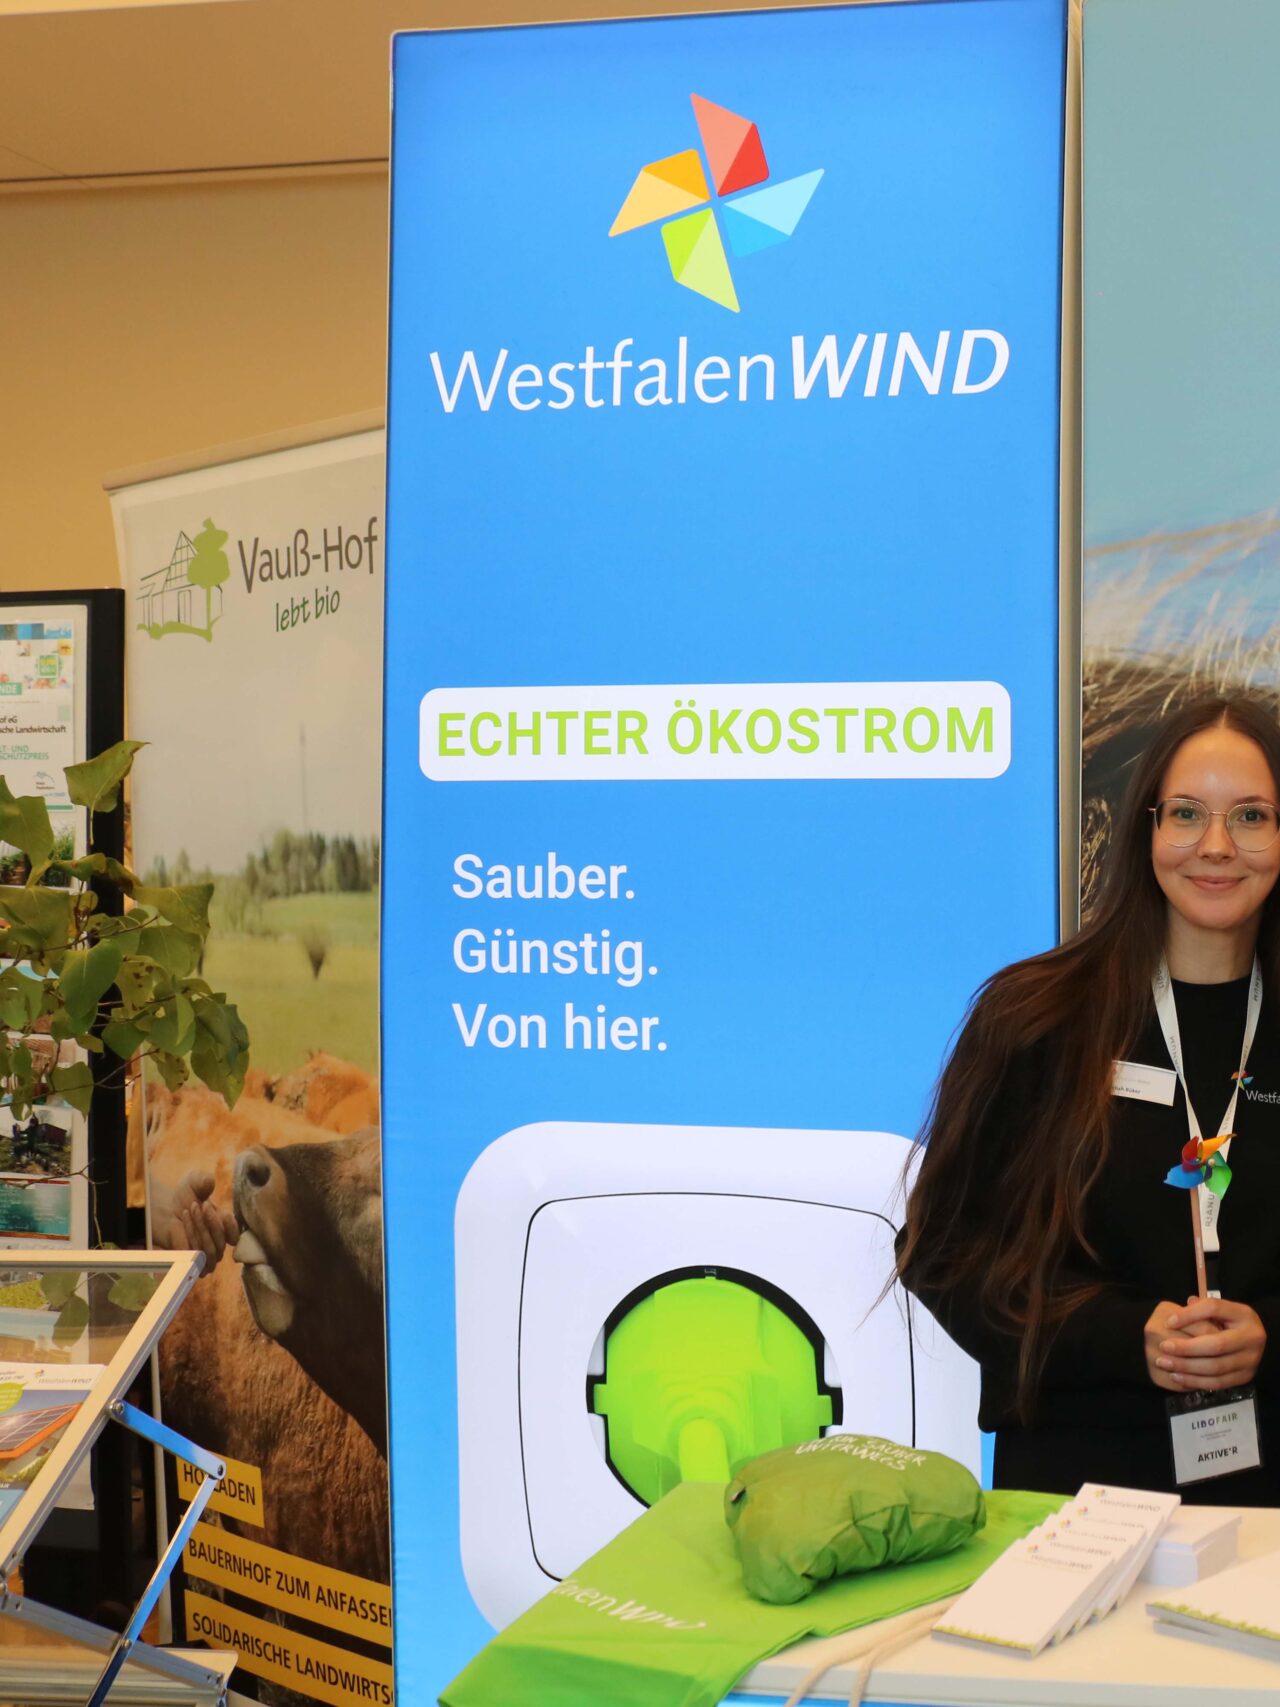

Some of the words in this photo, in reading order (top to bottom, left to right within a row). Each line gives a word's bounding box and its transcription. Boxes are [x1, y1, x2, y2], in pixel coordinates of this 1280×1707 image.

[237, 517, 378, 594] Vauß-Hof
[275, 598, 311, 633] lebt
[314, 586, 341, 622] bio
[15, 725, 67, 734] Landwirtschaft
[437, 710, 649, 757] ECHTER
[667, 699, 994, 755] ÖKOSTROM
[452, 851, 636, 900] Sauber.
[452, 928, 658, 987] Günstig.
[451, 1003, 547, 1048] Von
[565, 1002, 668, 1051] hier.
[183, 1464, 257, 1506] HOADEN
[188, 1538, 272, 1586] BAUERNHOF
[275, 1570, 311, 1601] ZUM
[192, 1612, 291, 1669] SOLIDARISCHE
[295, 1653, 394, 1704] LANDWIRTS
